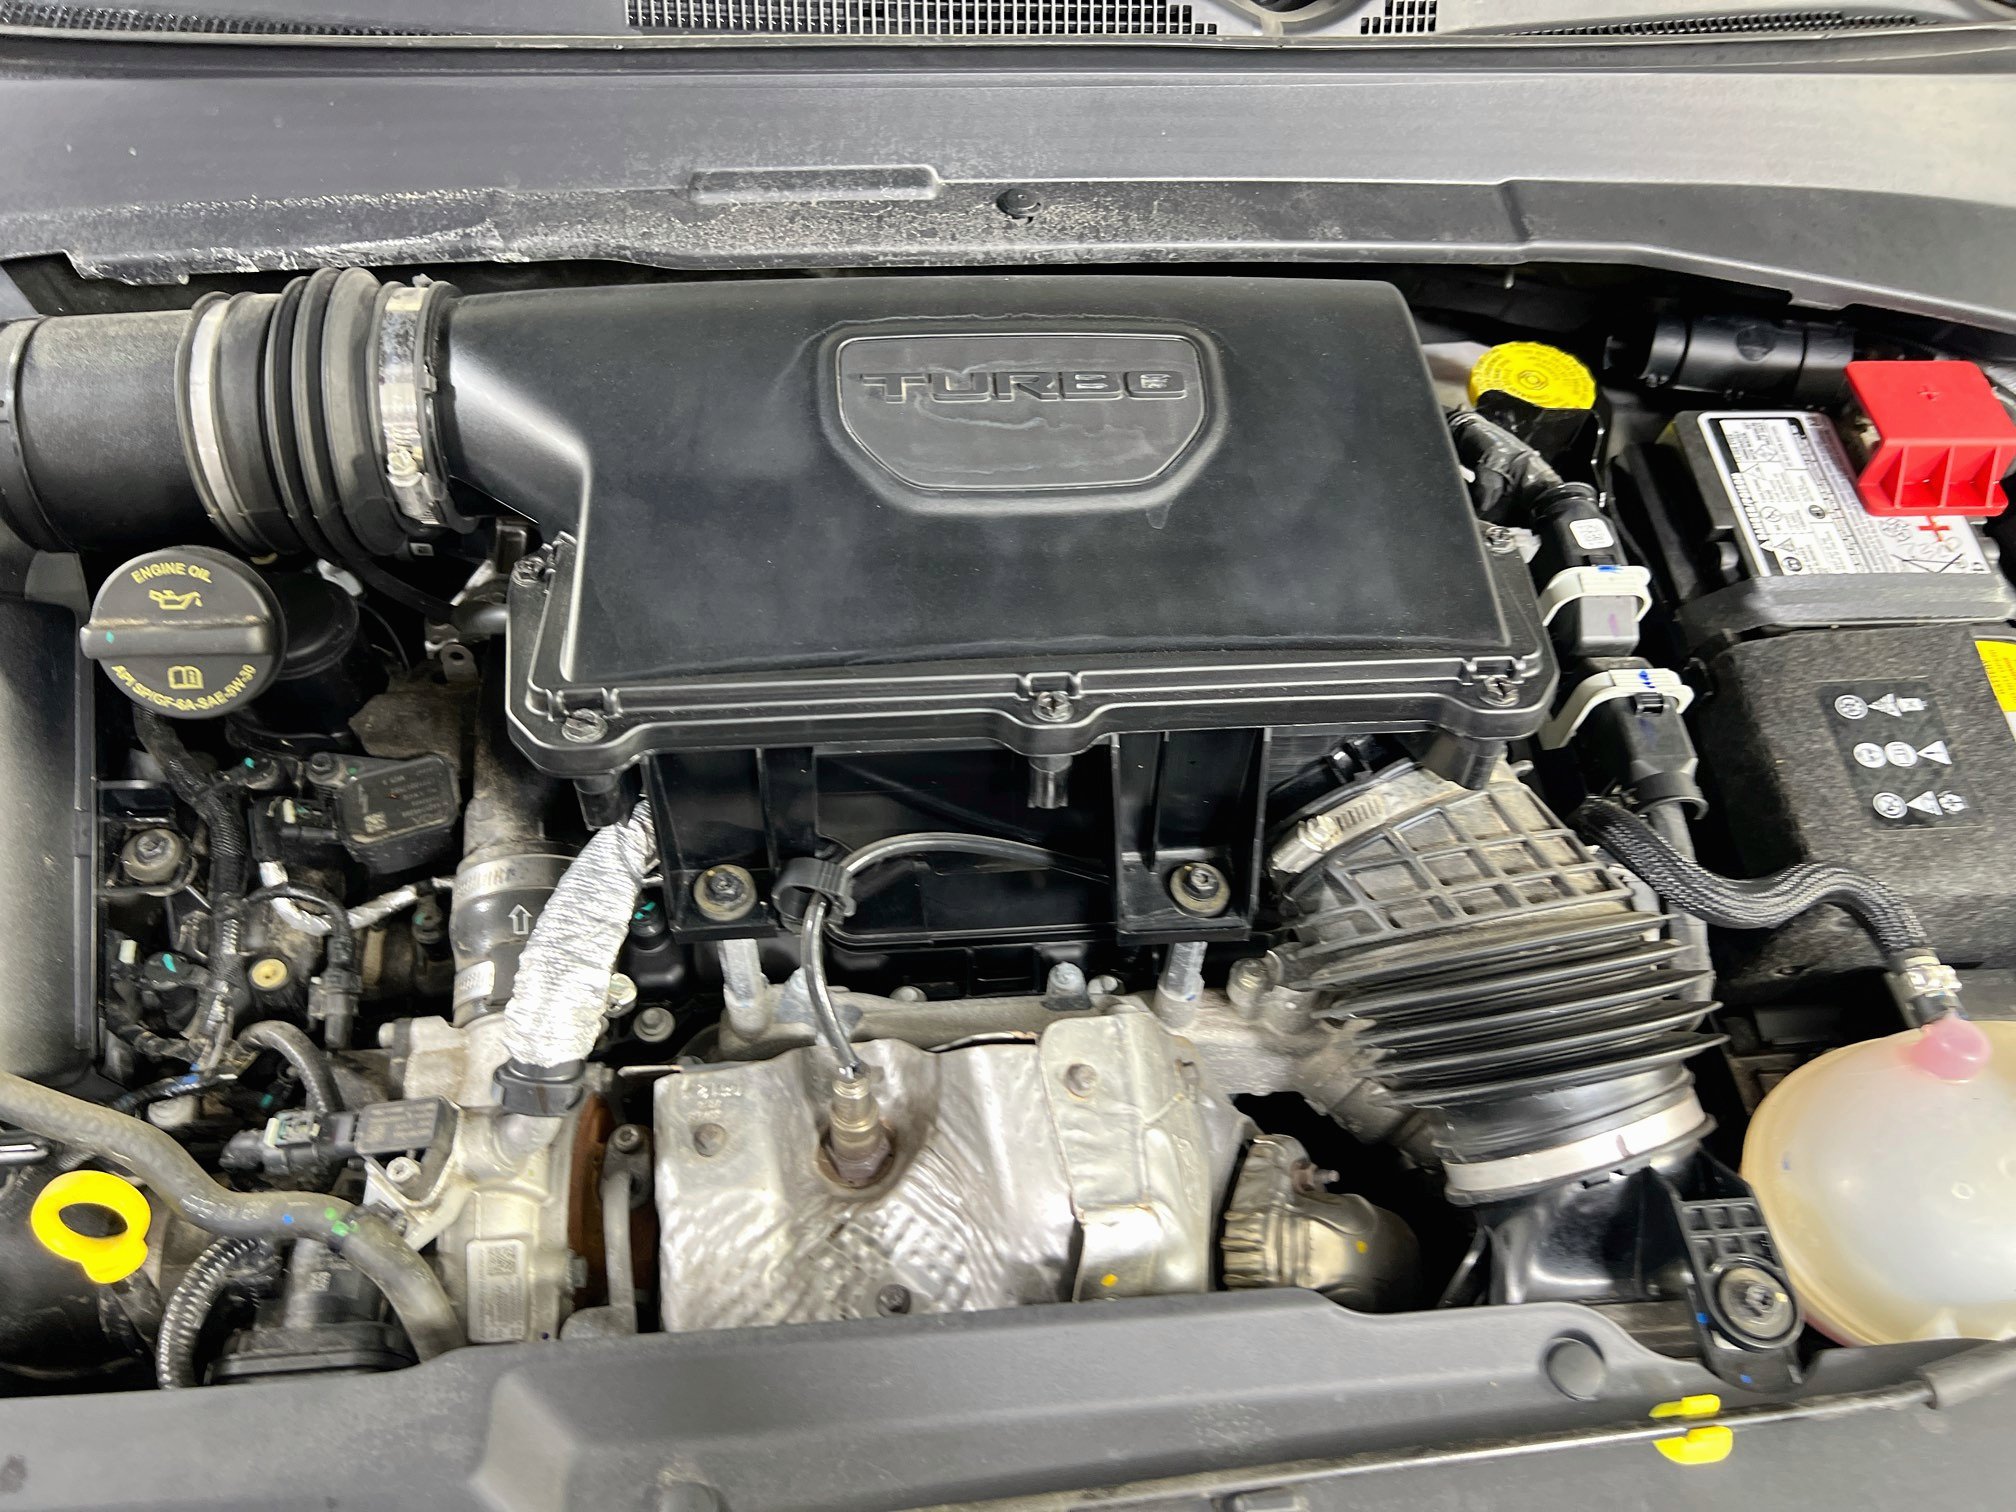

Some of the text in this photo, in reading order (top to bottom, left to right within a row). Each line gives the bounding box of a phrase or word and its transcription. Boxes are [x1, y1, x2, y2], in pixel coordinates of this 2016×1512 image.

[861, 371, 1188, 403] TURBO
[131, 562, 213, 584] ENGINE OIL
